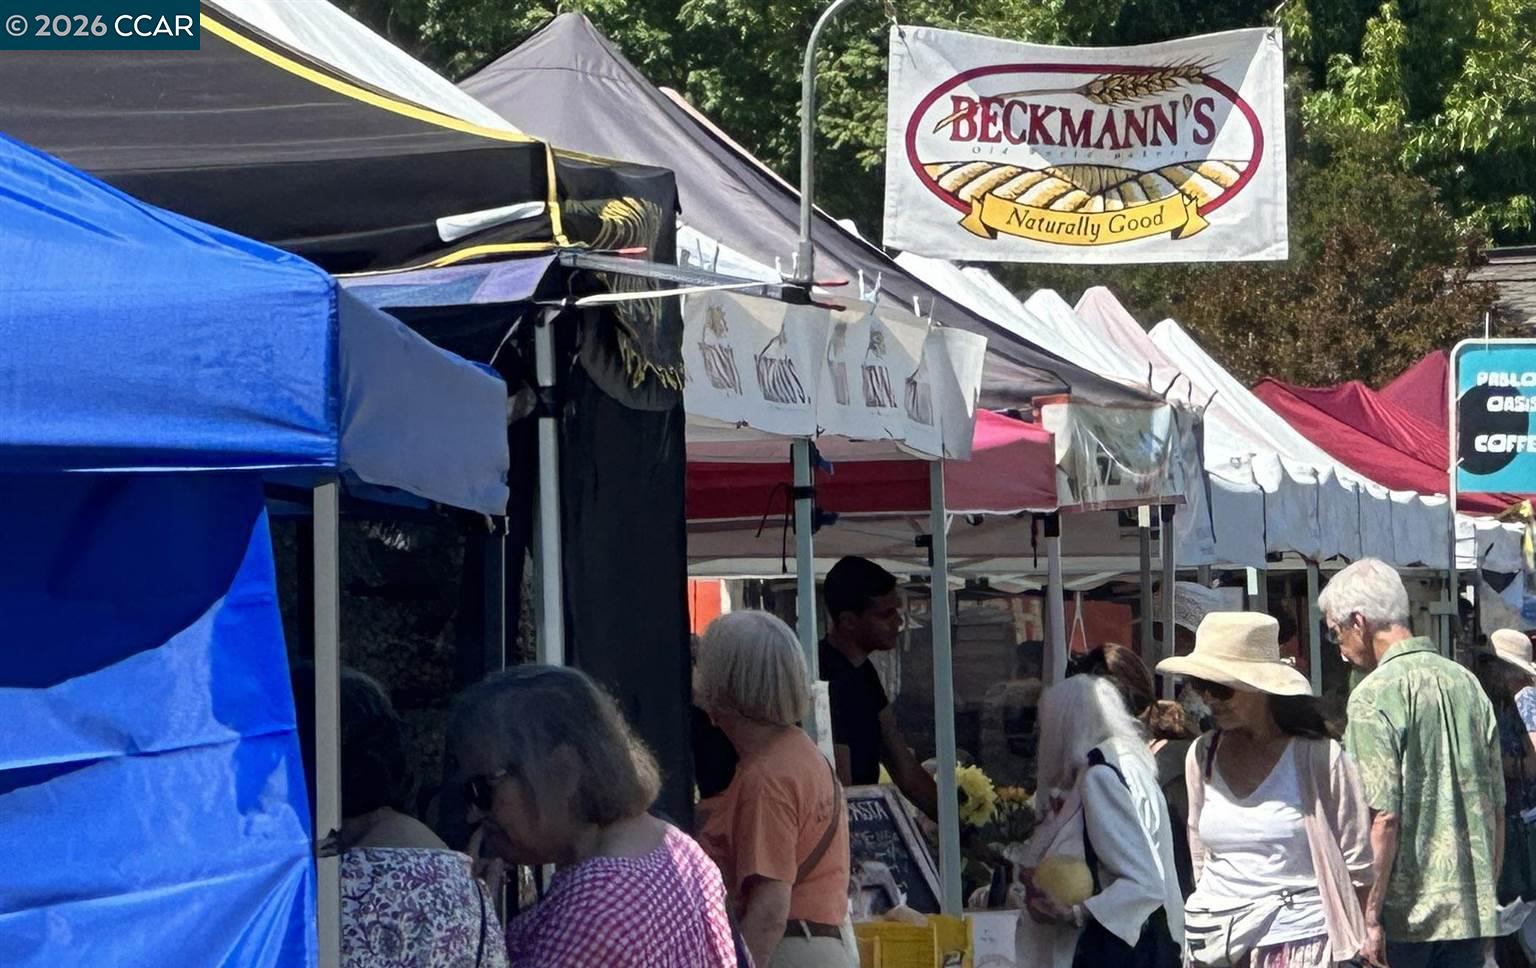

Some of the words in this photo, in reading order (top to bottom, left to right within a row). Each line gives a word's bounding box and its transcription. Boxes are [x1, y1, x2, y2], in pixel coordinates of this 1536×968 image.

[949, 94, 1217, 150] BECKMANN'S
[1005, 206, 1101, 243] Naturally
[1108, 205, 1165, 235] Good
